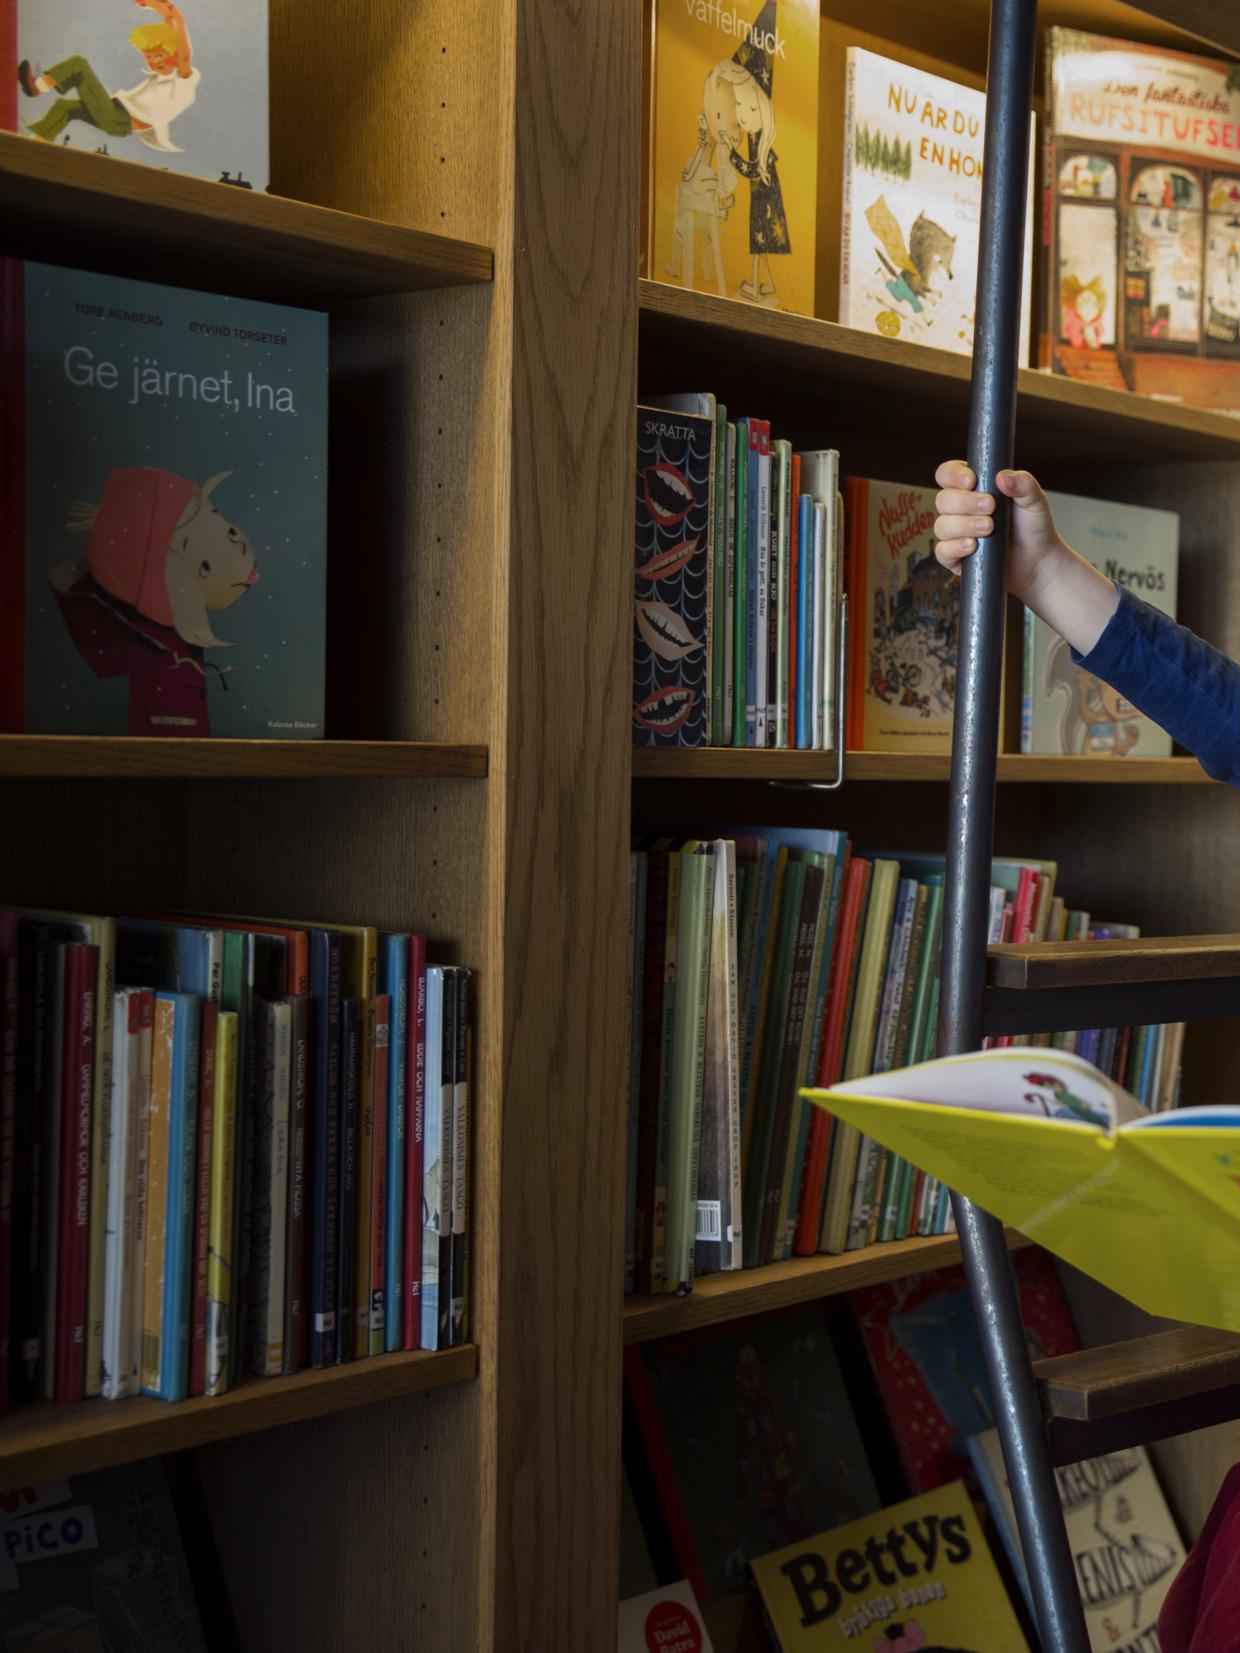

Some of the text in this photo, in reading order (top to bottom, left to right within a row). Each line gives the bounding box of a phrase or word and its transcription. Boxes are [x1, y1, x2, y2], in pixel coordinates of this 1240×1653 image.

[887, 80, 918, 115] NU
[952, 109, 980, 139] DU
[919, 135, 945, 167] EN
[74, 303, 163, 327] TORE RENBERG
[188, 321, 288, 347] ØYVIND TORSETER
[64, 345, 296, 413] Ge järnet, Ina
[644, 420, 697, 442] SKRATTA
[1104, 556, 1167, 592] Nervös
[832, 866, 844, 897] Olivier
[212, 961, 222, 979] Per
[814, 1018, 823, 1036] kan
[415, 1041, 425, 1067] EDDIE
[811, 1037, 820, 1052] det
[415, 1070, 425, 1092] OCH
[327, 1090, 337, 1116] OCH
[414, 1095, 424, 1143] NAPPARNA
[78, 1150, 88, 1174] OCH
[137, 1158, 146, 1175] Den
[137, 1176, 146, 1198] vilda
[3, 1516, 86, 1559] PiCO
[778, 1513, 974, 1630] Bettys
[654, 1620, 690, 1644] David
